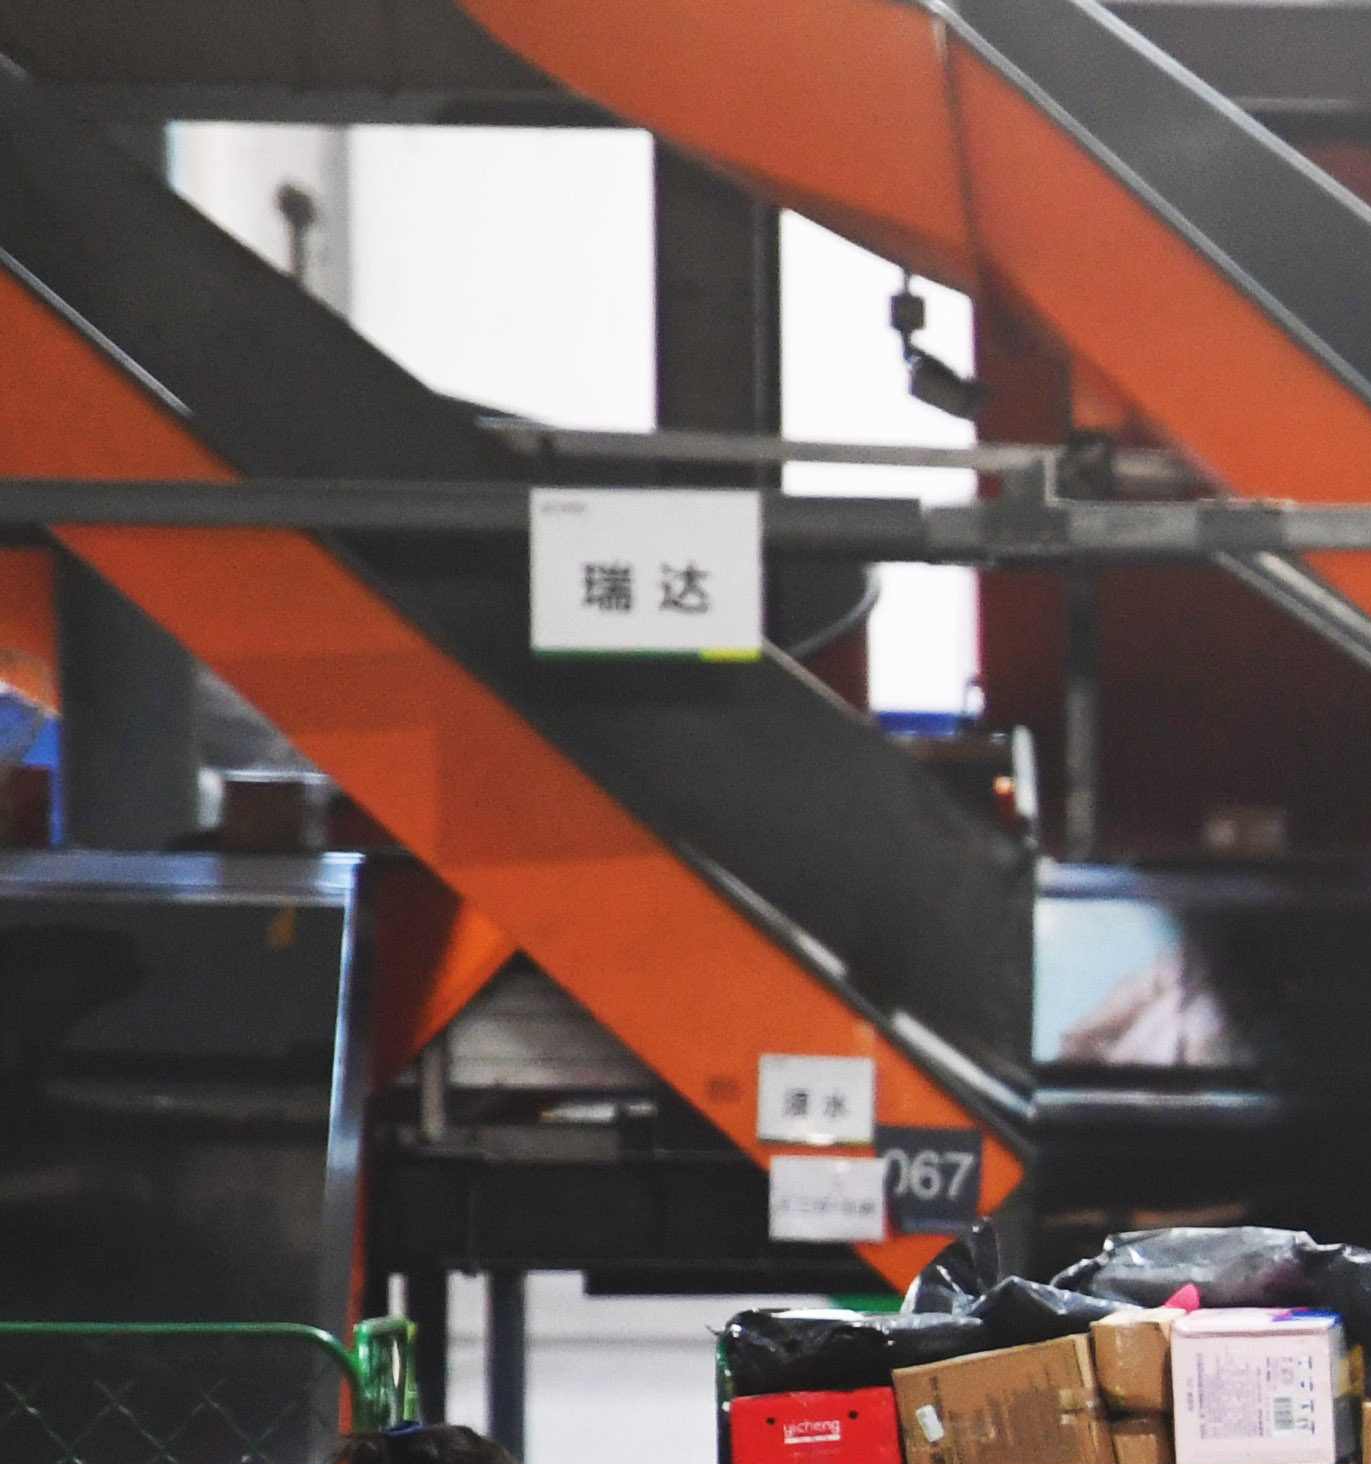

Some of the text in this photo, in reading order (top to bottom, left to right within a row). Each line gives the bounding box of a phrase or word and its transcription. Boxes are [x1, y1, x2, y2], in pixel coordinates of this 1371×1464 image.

[582, 561, 710, 614] 瑞达
[885, 1149, 974, 1200] 067
[783, 1419, 840, 1437] yicheng
